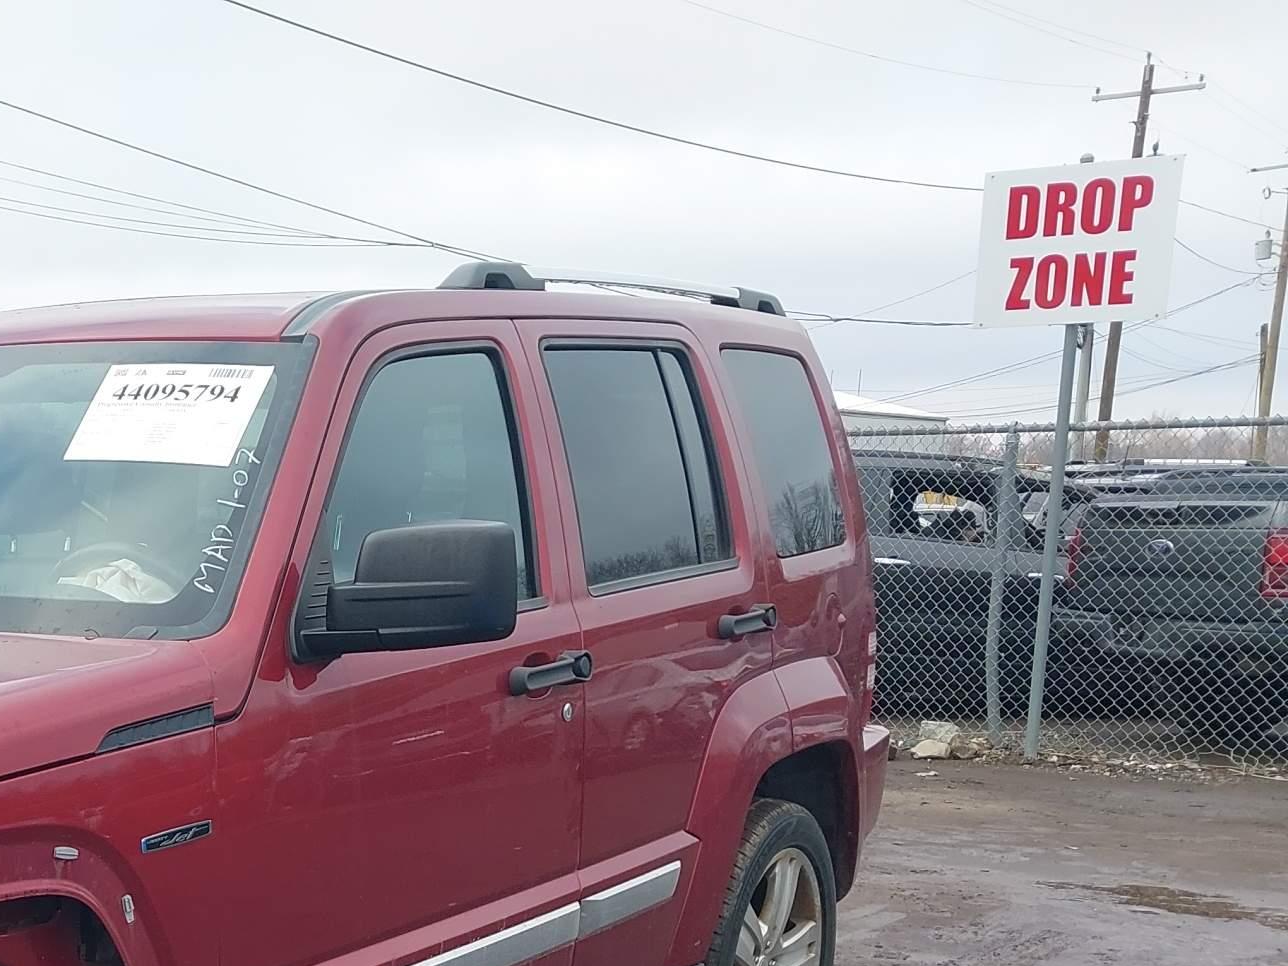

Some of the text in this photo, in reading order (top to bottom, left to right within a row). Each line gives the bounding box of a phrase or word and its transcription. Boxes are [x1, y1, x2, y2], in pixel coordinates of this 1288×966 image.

[1005, 175, 1154, 240] DROP
[1005, 249, 1137, 311] ZONE
[113, 383, 242, 402] 44095794
[193, 524, 234, 593] MAD
